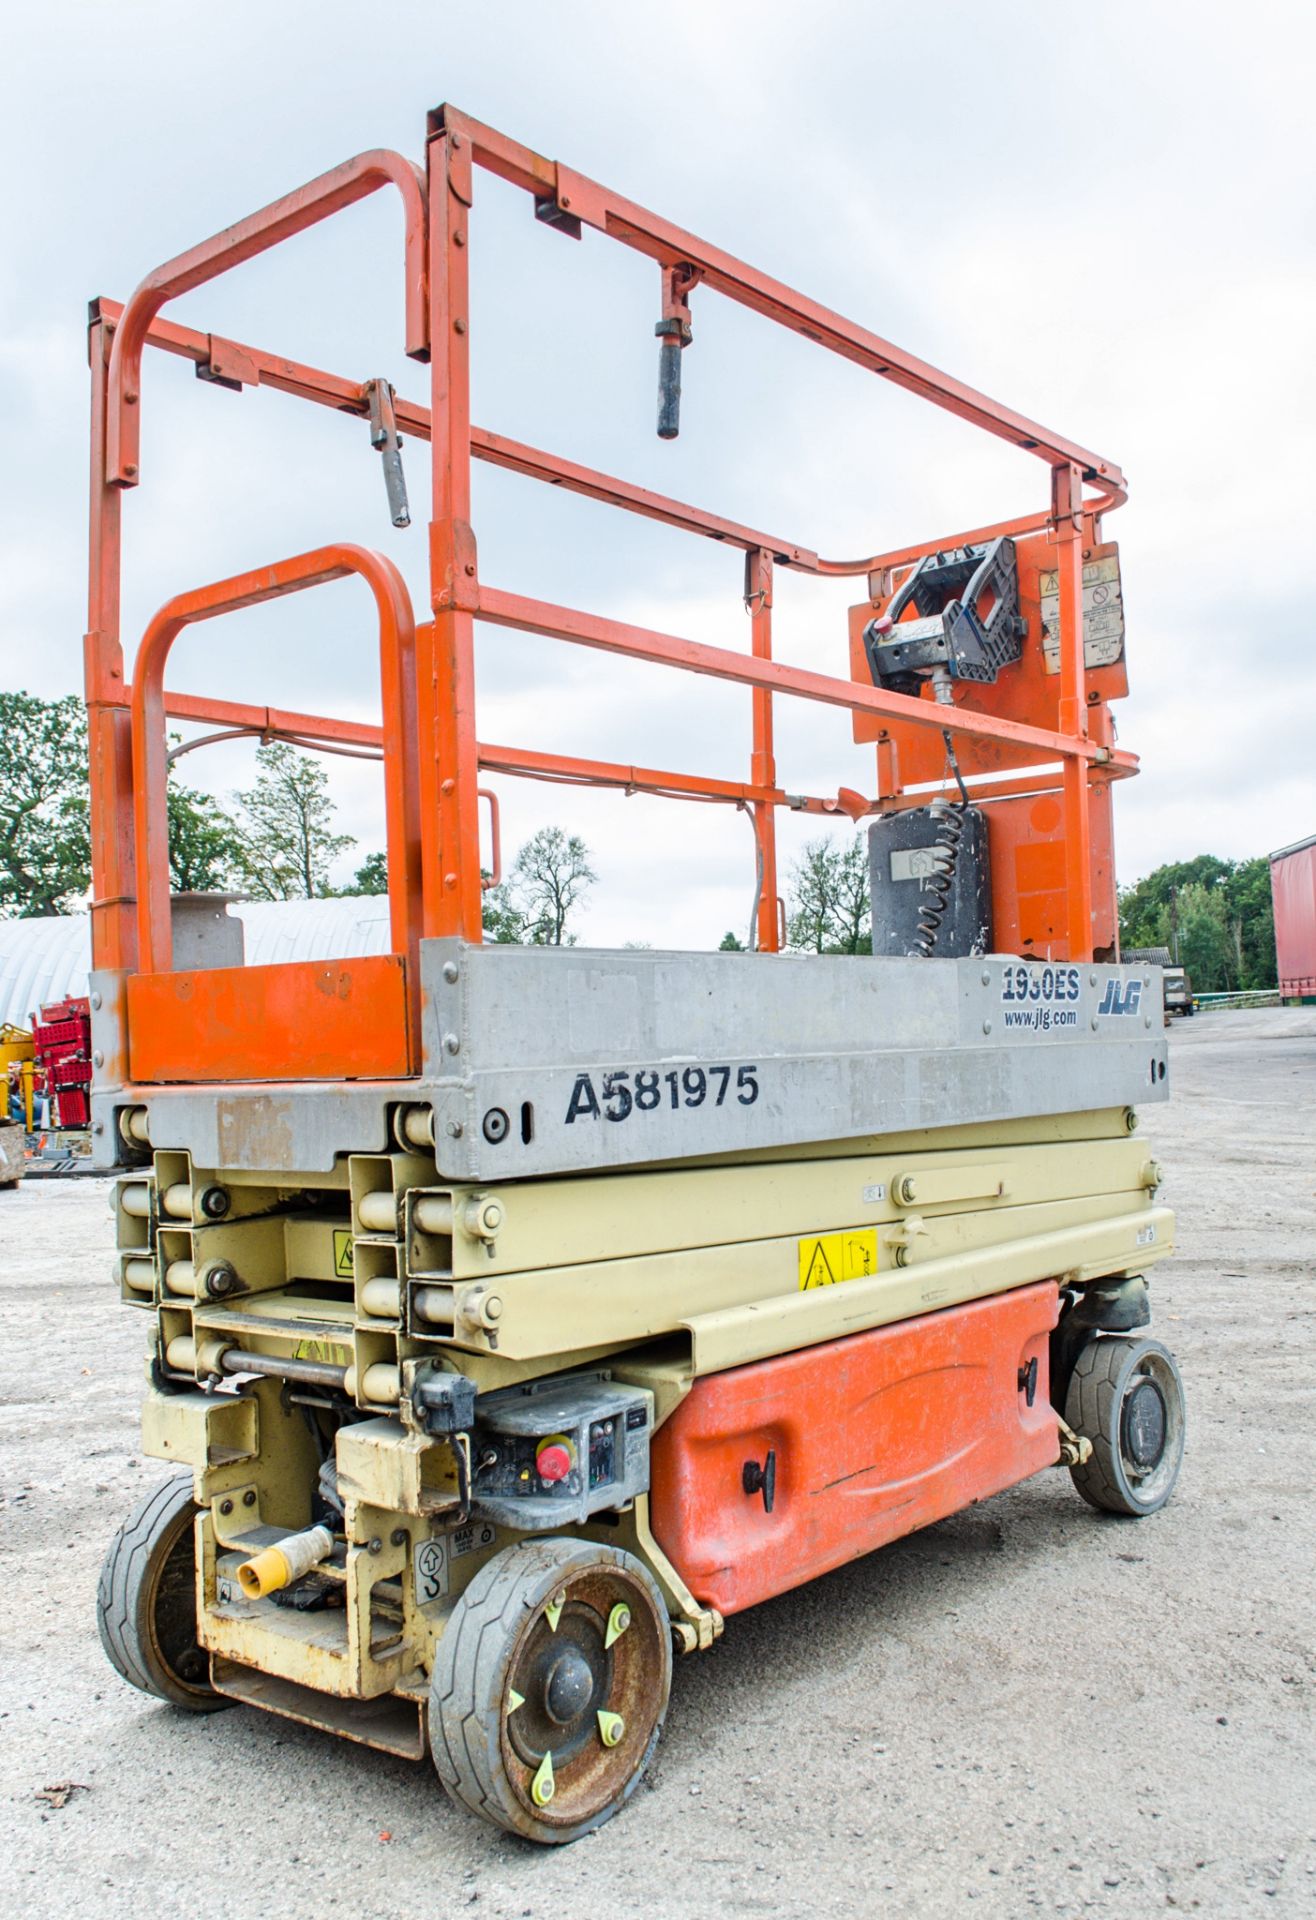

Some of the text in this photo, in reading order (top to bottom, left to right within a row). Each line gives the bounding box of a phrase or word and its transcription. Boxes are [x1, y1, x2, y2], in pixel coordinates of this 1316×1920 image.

[1098, 979, 1142, 1016] JLG
[1004, 1008, 1077, 1031] www.jlg.com
[564, 1065, 759, 1124] A581975
